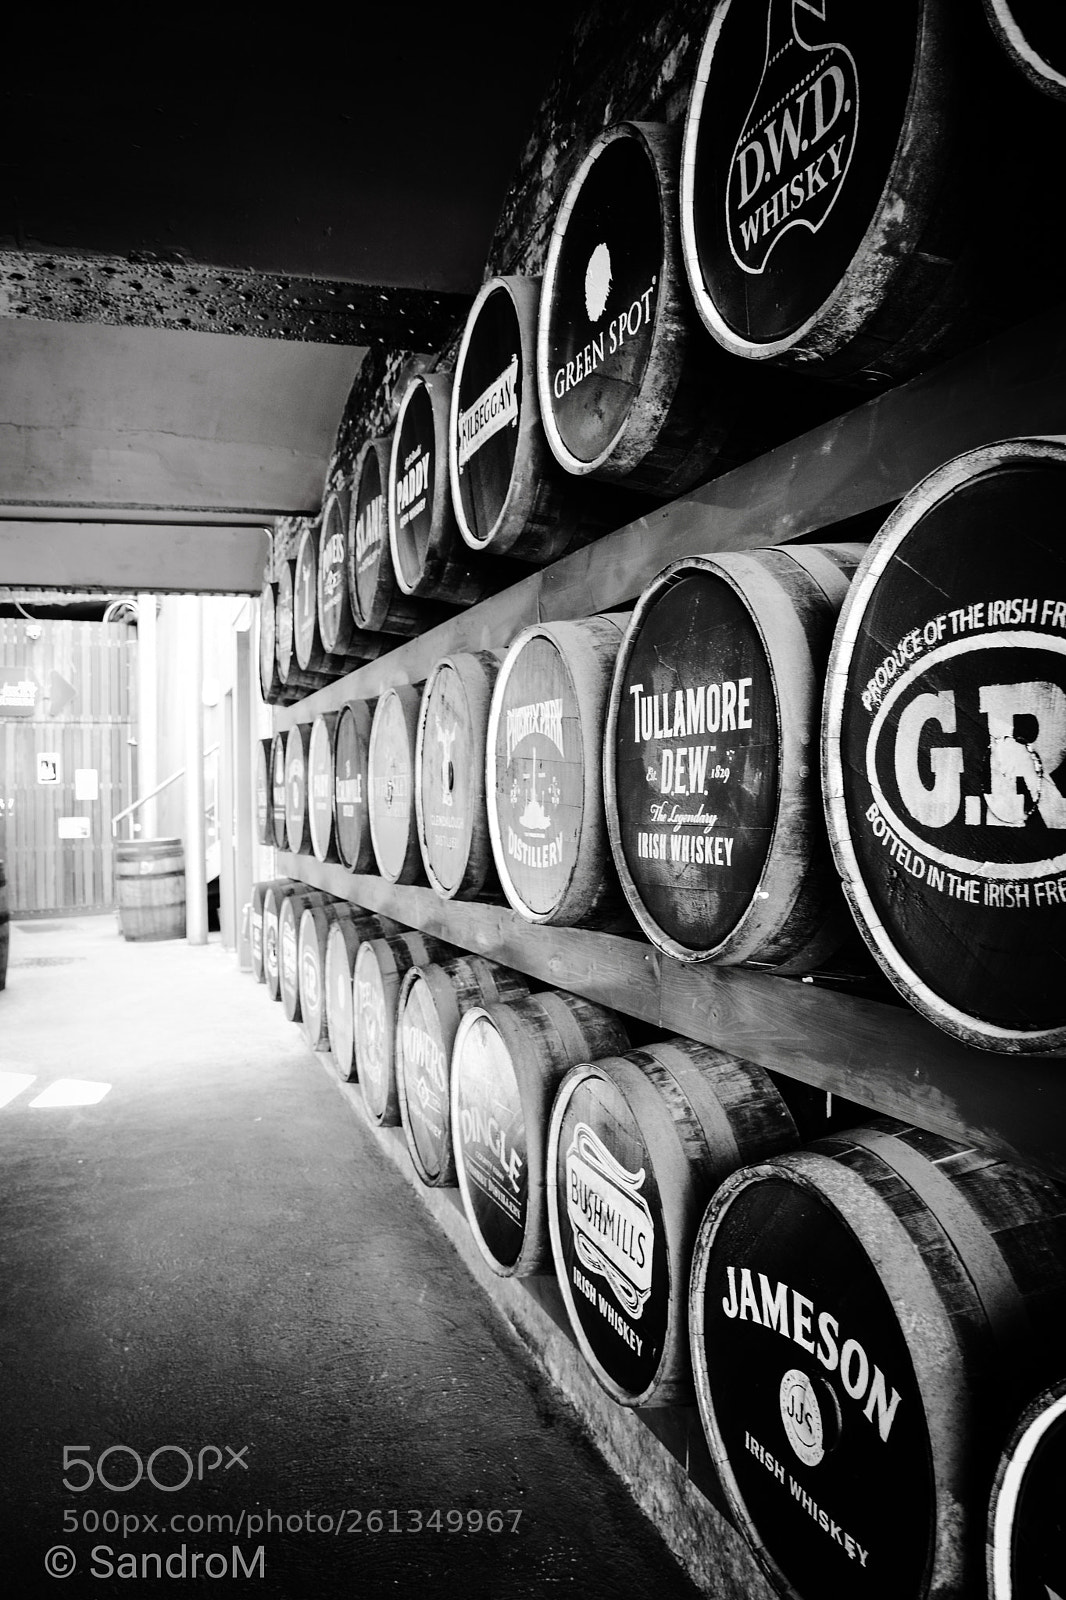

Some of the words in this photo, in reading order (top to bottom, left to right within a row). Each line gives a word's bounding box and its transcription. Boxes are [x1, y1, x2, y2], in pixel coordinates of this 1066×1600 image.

[737, 65, 851, 209] D.W.D.
[738, 135, 846, 251] WHISKY
[554, 332, 605, 398] GREEN
[609, 286, 654, 354] SPOT
[462, 376, 511, 449] KILBEGGAN
[397, 452, 430, 514] PADDY
[861, 630, 923, 712] PRODUCE
[924, 615, 946, 647] OF
[948, 603, 984, 635] THE
[987, 598, 1038, 627] IRISH
[630, 677, 752, 743] TULLAMORE
[650, 801, 669, 822] The
[667, 804, 718, 834] Legendary
[711, 765, 730, 784] 1829
[508, 825, 563, 868] DISTILLERY
[638, 832, 667, 861] IRISH
[671, 834, 734, 867] WHISKEY
[865, 802, 926, 879] BOTTELD
[927, 864, 944, 892] IN
[947, 872, 980, 903] THE
[984, 883, 1030, 908] IRISH
[571, 1168, 645, 1269] BUSHMILLS
[573, 1265, 597, 1307] IRISH
[598, 1297, 643, 1358] WHISKEY
[722, 1266, 902, 1442] JAMESON
[745, 1431, 785, 1484] IRISH
[789, 1475, 869, 1567] WHISKEY
